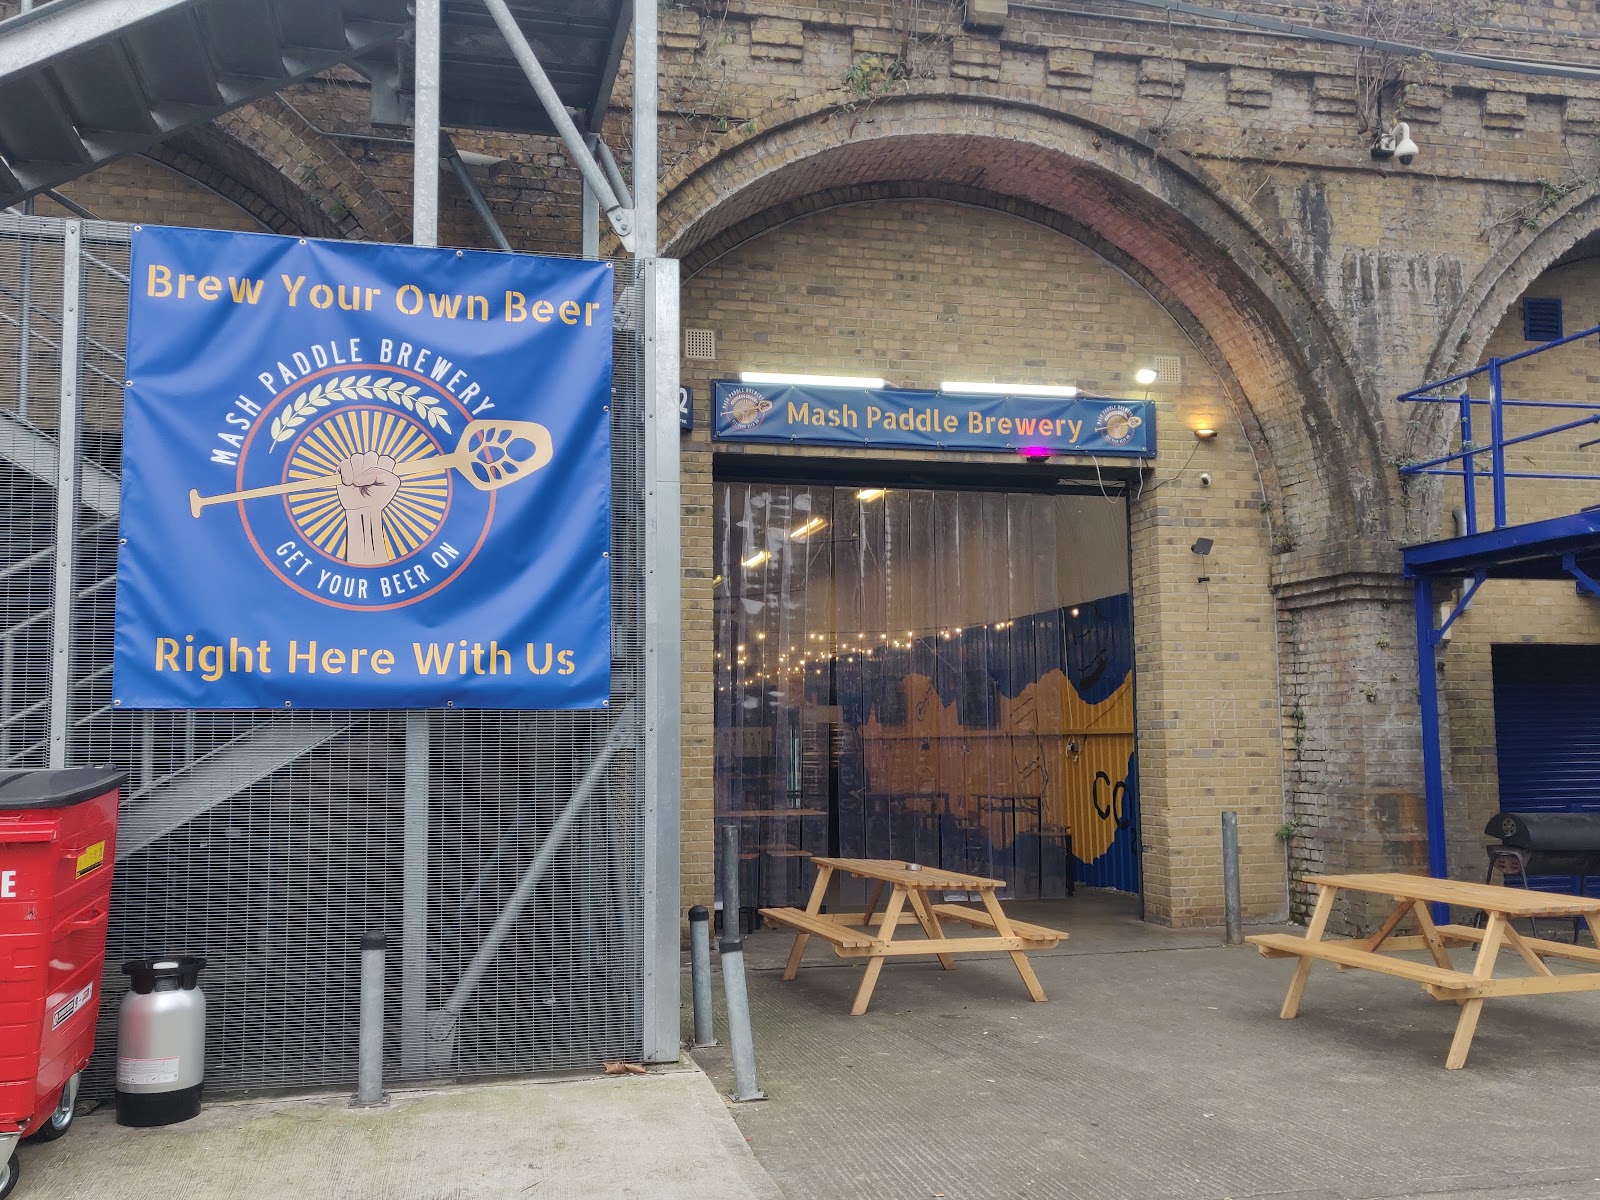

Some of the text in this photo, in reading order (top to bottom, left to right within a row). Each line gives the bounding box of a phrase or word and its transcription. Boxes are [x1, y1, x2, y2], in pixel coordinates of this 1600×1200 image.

[147, 264, 600, 326] Brew Your Own Beer
[210, 338, 495, 466] MASH PADDLE BREWERY
[787, 401, 858, 428] Mash
[866, 406, 959, 433] Paddle
[968, 411, 1083, 444] Brewery
[275, 540, 460, 599] GET YOUR BEER ON
[155, 634, 575, 682] Right Here With Us
[1, 870, 17, 898] E
